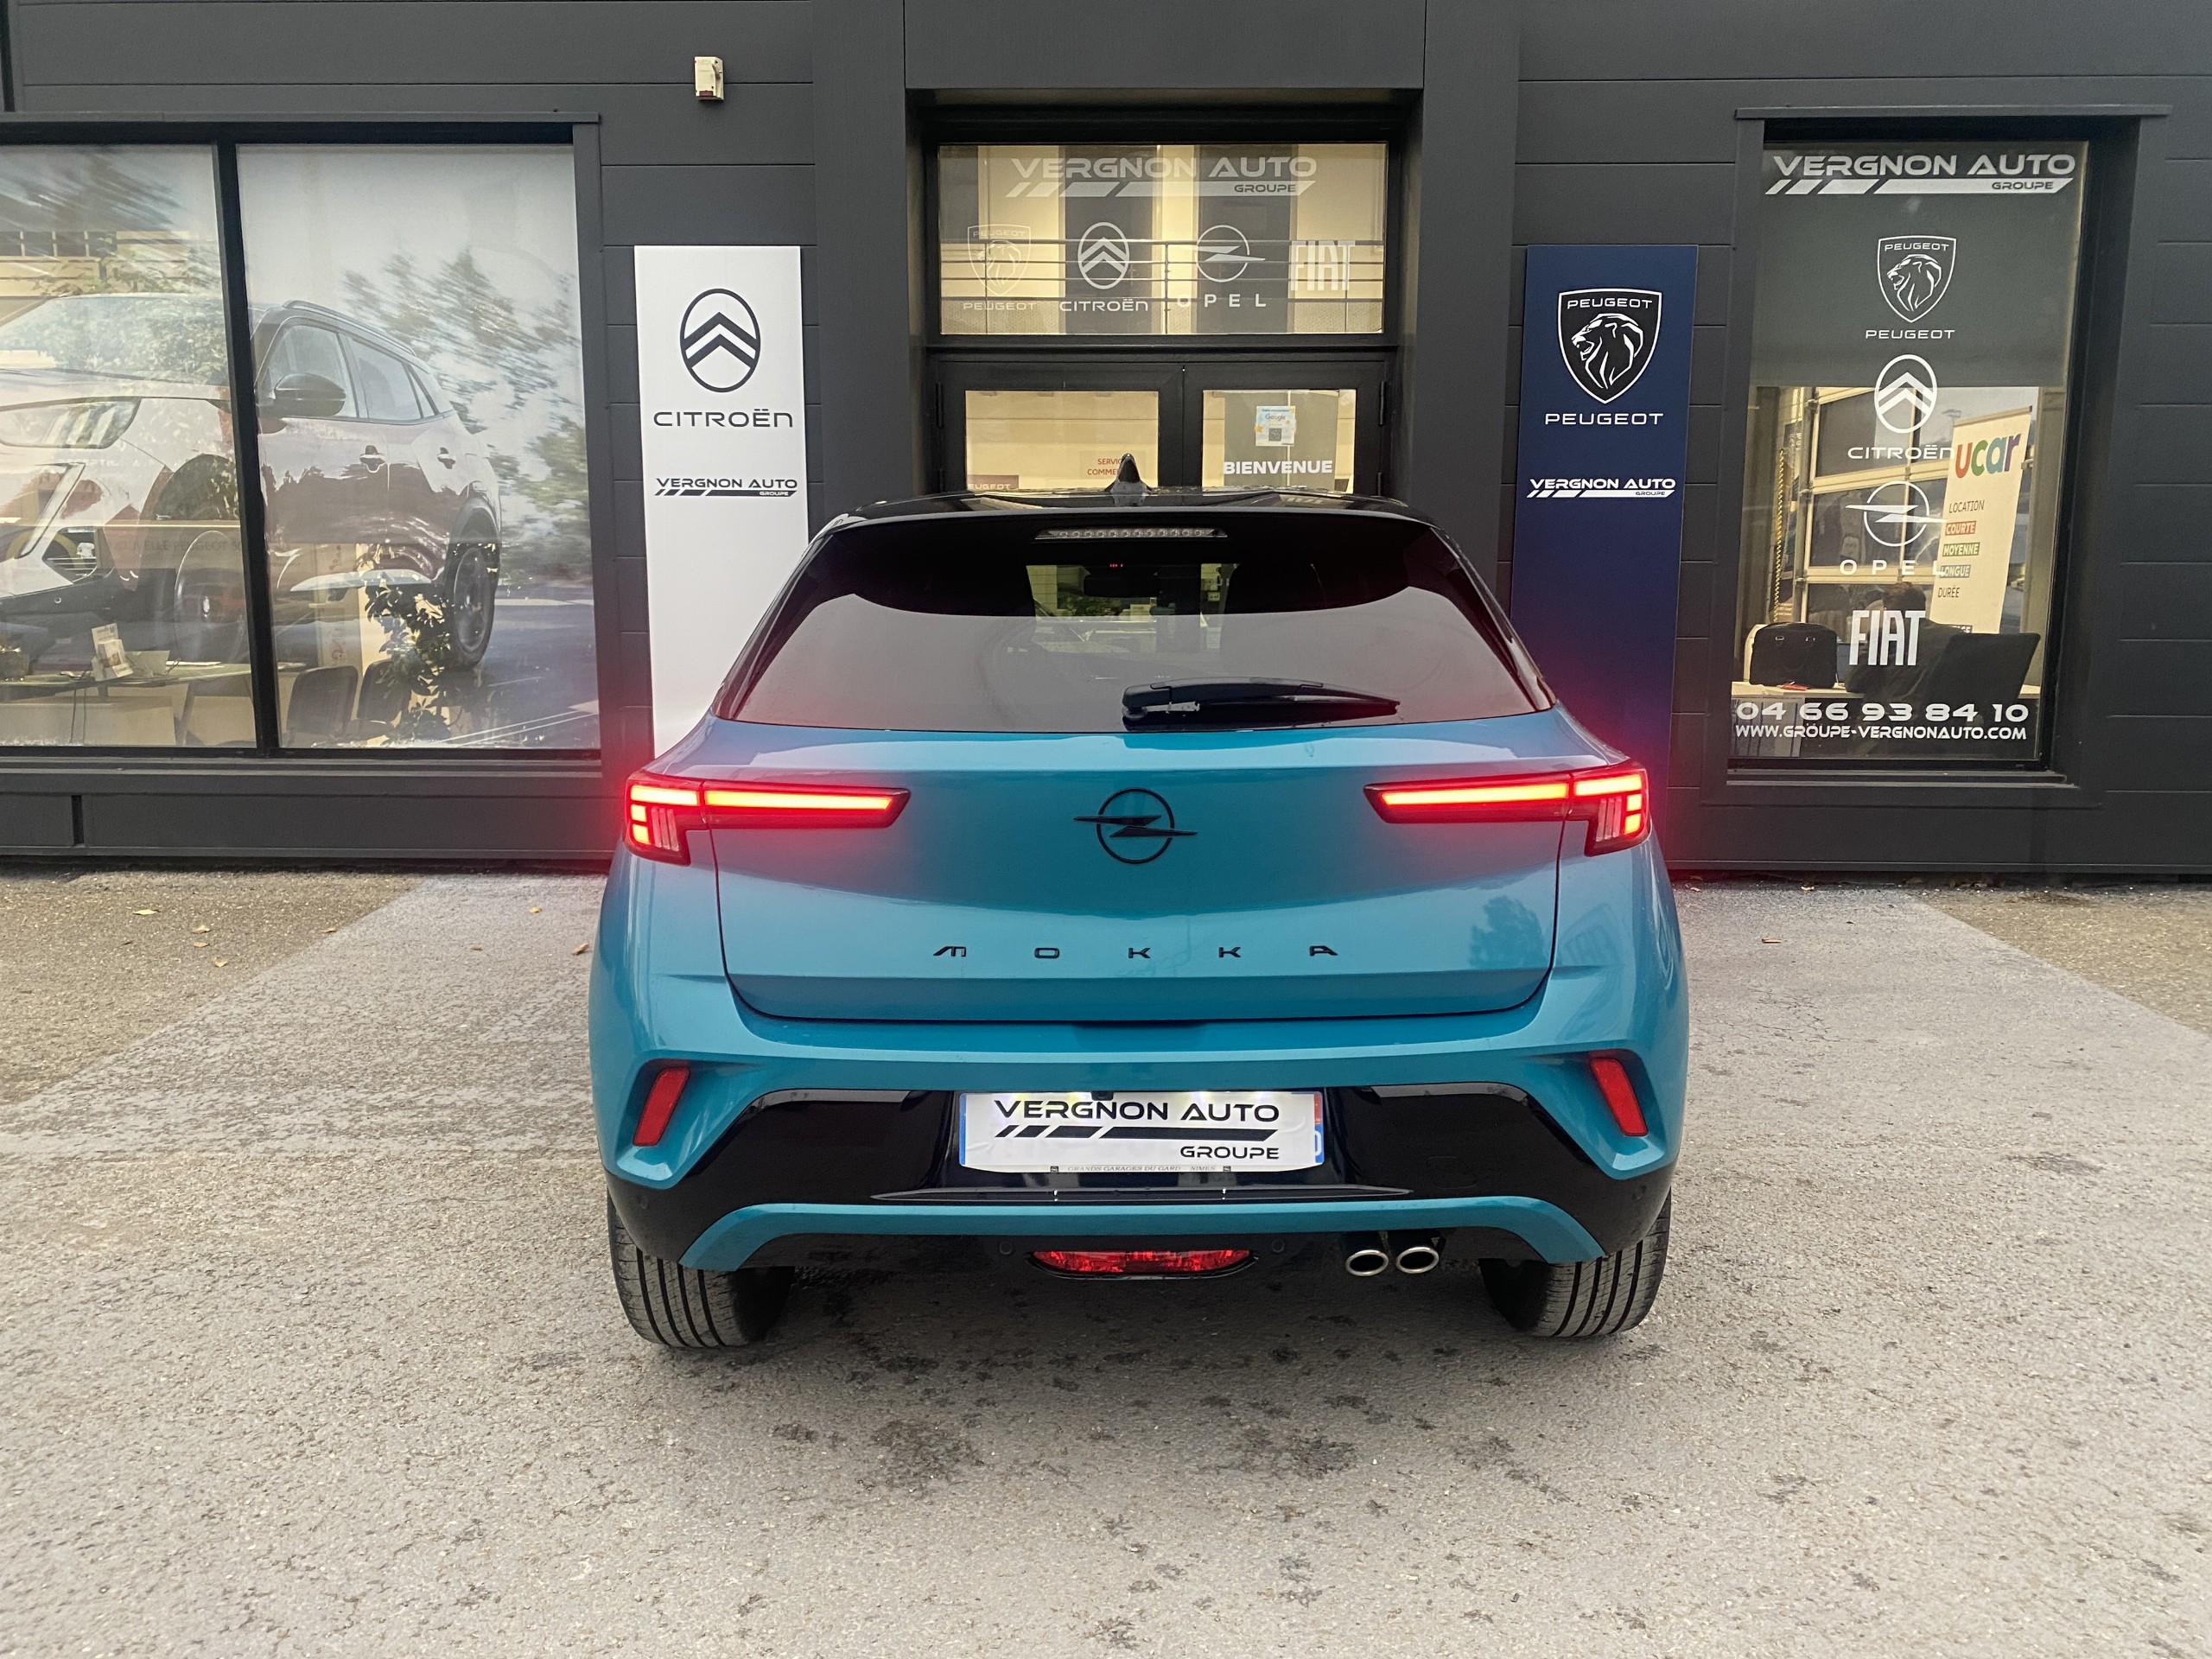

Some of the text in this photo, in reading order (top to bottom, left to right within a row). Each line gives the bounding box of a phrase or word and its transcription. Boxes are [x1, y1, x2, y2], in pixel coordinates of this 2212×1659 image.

[1011, 156, 1317, 178] VERGNON AUTO
[1773, 154, 2075, 176] VERGNON AUTO
[1234, 184, 1297, 193] GROUPE
[1992, 181, 2054, 190] GROUPE
[1885, 243, 1949, 251] PEUGEOT
[1291, 240, 1356, 291] FIAT
[1058, 298, 1149, 312] CITROËN
[1177, 293, 1267, 308] OPEL
[1567, 298, 1652, 309] PEUGEOT
[1866, 329, 1955, 340] PEUGEOT
[653, 409, 793, 428] CITROËN
[1545, 413, 1664, 425] PEUGEOT
[1955, 434, 2022, 479] ucar
[1224, 461, 1332, 474] BIENVENUE
[656, 478, 798, 488] VERGNON AUTO
[1529, 478, 1676, 489] VERGNON AUTO
[1948, 499, 1985, 513] LOCATION
[1946, 521, 1975, 534] COURTE
[1943, 543, 1980, 556] MOYENNE
[1840, 559, 1945, 575] OPEL
[1937, 585, 1961, 598] DURÉE
[1849, 610, 1926, 666] FIAT
[1736, 702, 2029, 722] 04 66 93 84 10
[1736, 724, 2027, 741] WWW.GROUPE-VERGNONAUTO.COM
[994, 1100, 1280, 1122] VERGNON AUTO
[1180, 1146, 1280, 1160] GROUPE
